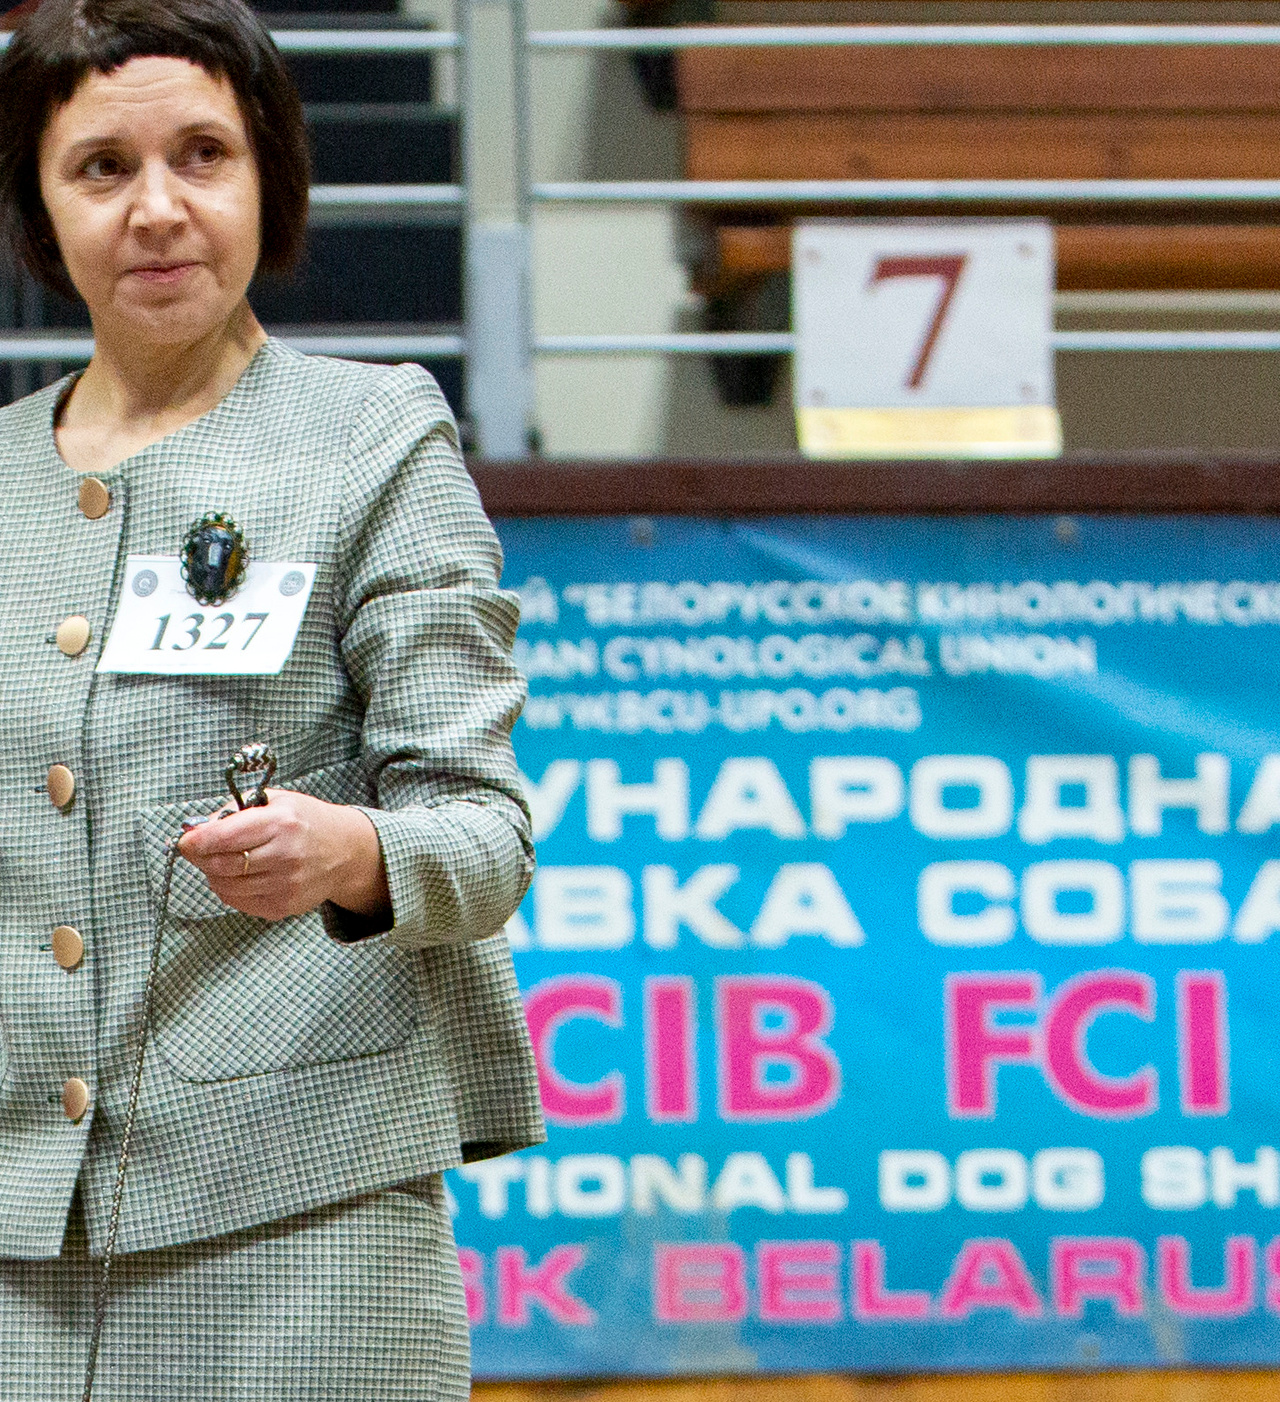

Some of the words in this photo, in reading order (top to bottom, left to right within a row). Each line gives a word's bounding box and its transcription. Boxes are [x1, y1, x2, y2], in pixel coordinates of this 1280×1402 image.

[868, 253, 968, 389] 7
[149, 611, 270, 652] 1327
[603, 634, 932, 680] CYNOLOGICAL
[939, 633, 1097, 679] UNION
[944, 968, 1230, 1120] FCI
[444, 1151, 848, 1219] TIONAL
[878, 1146, 1105, 1212] DOG
[653, 1233, 1280, 1325] BELARU
